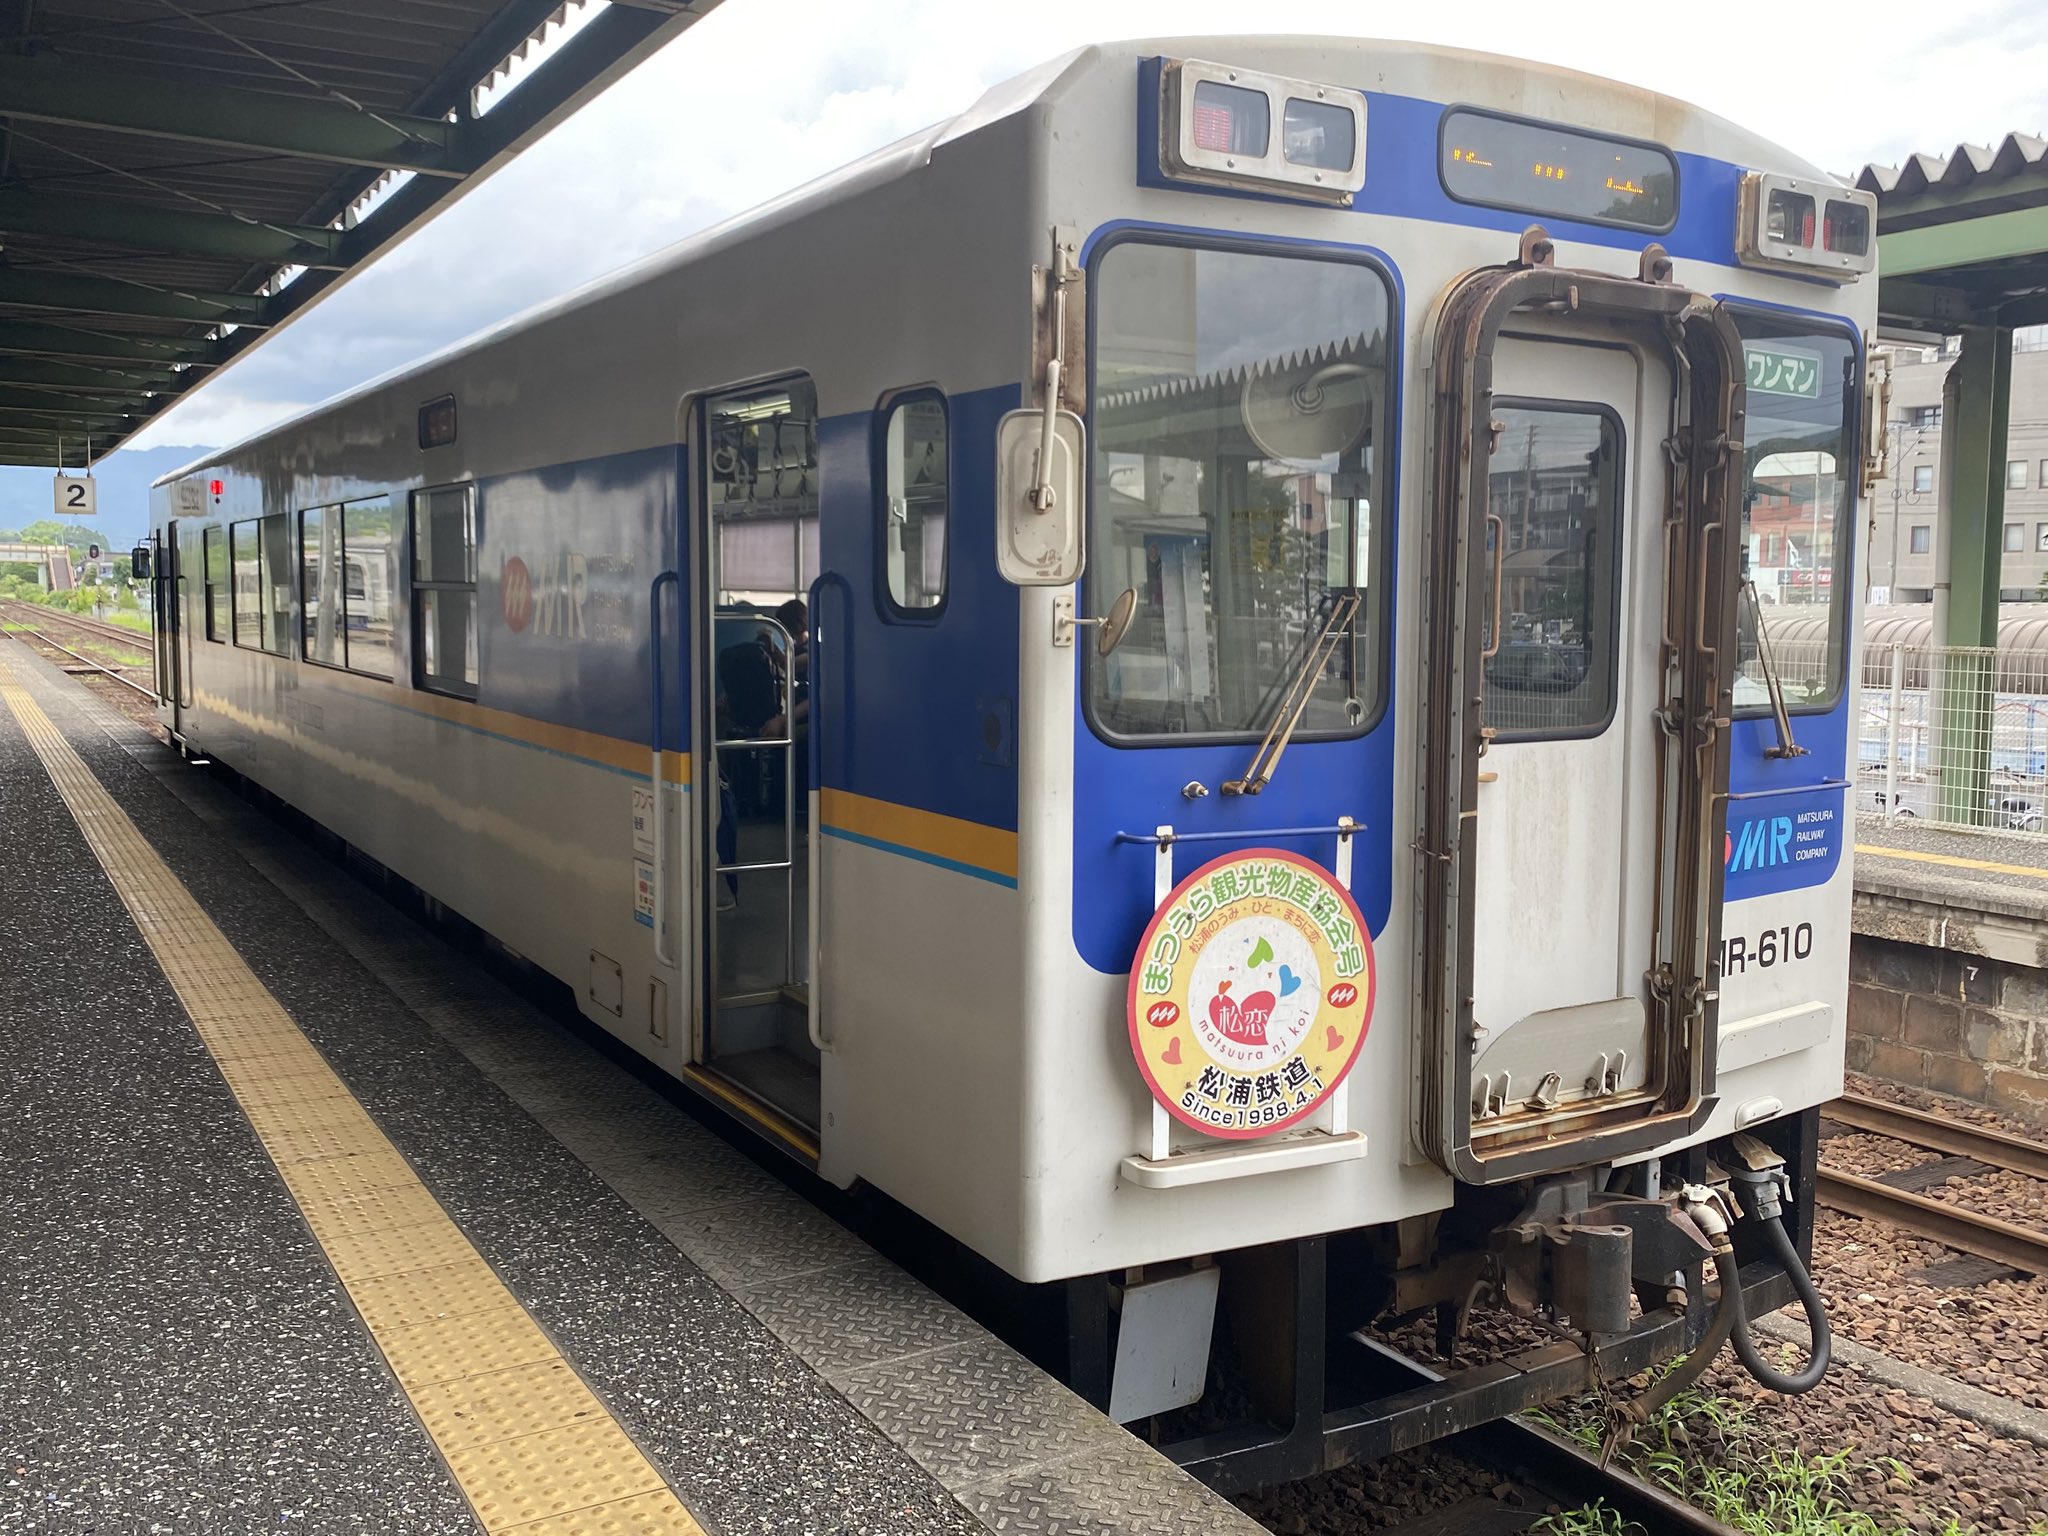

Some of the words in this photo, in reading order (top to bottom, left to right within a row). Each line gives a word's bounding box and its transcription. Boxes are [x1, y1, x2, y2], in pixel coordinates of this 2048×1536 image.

[1747, 354, 1814, 393] ワンマン
[68, 484, 86, 507] 2
[1797, 809, 1833, 823] MATSUURA
[1730, 816, 1793, 873] MR
[1796, 829, 1825, 842] RAILWAY
[1795, 847, 1828, 861] COMPANY
[1144, 864, 1362, 991] まつうら観光物産協会号
[1200, 1019, 1263, 1060] matsuura
[1272, 1037, 1286, 1054] ni
[1292, 1009, 1310, 1036] koi
[1218, 1005, 1268, 1037] 松恋
[1198, 1057, 1311, 1106] 松浦鉄道
